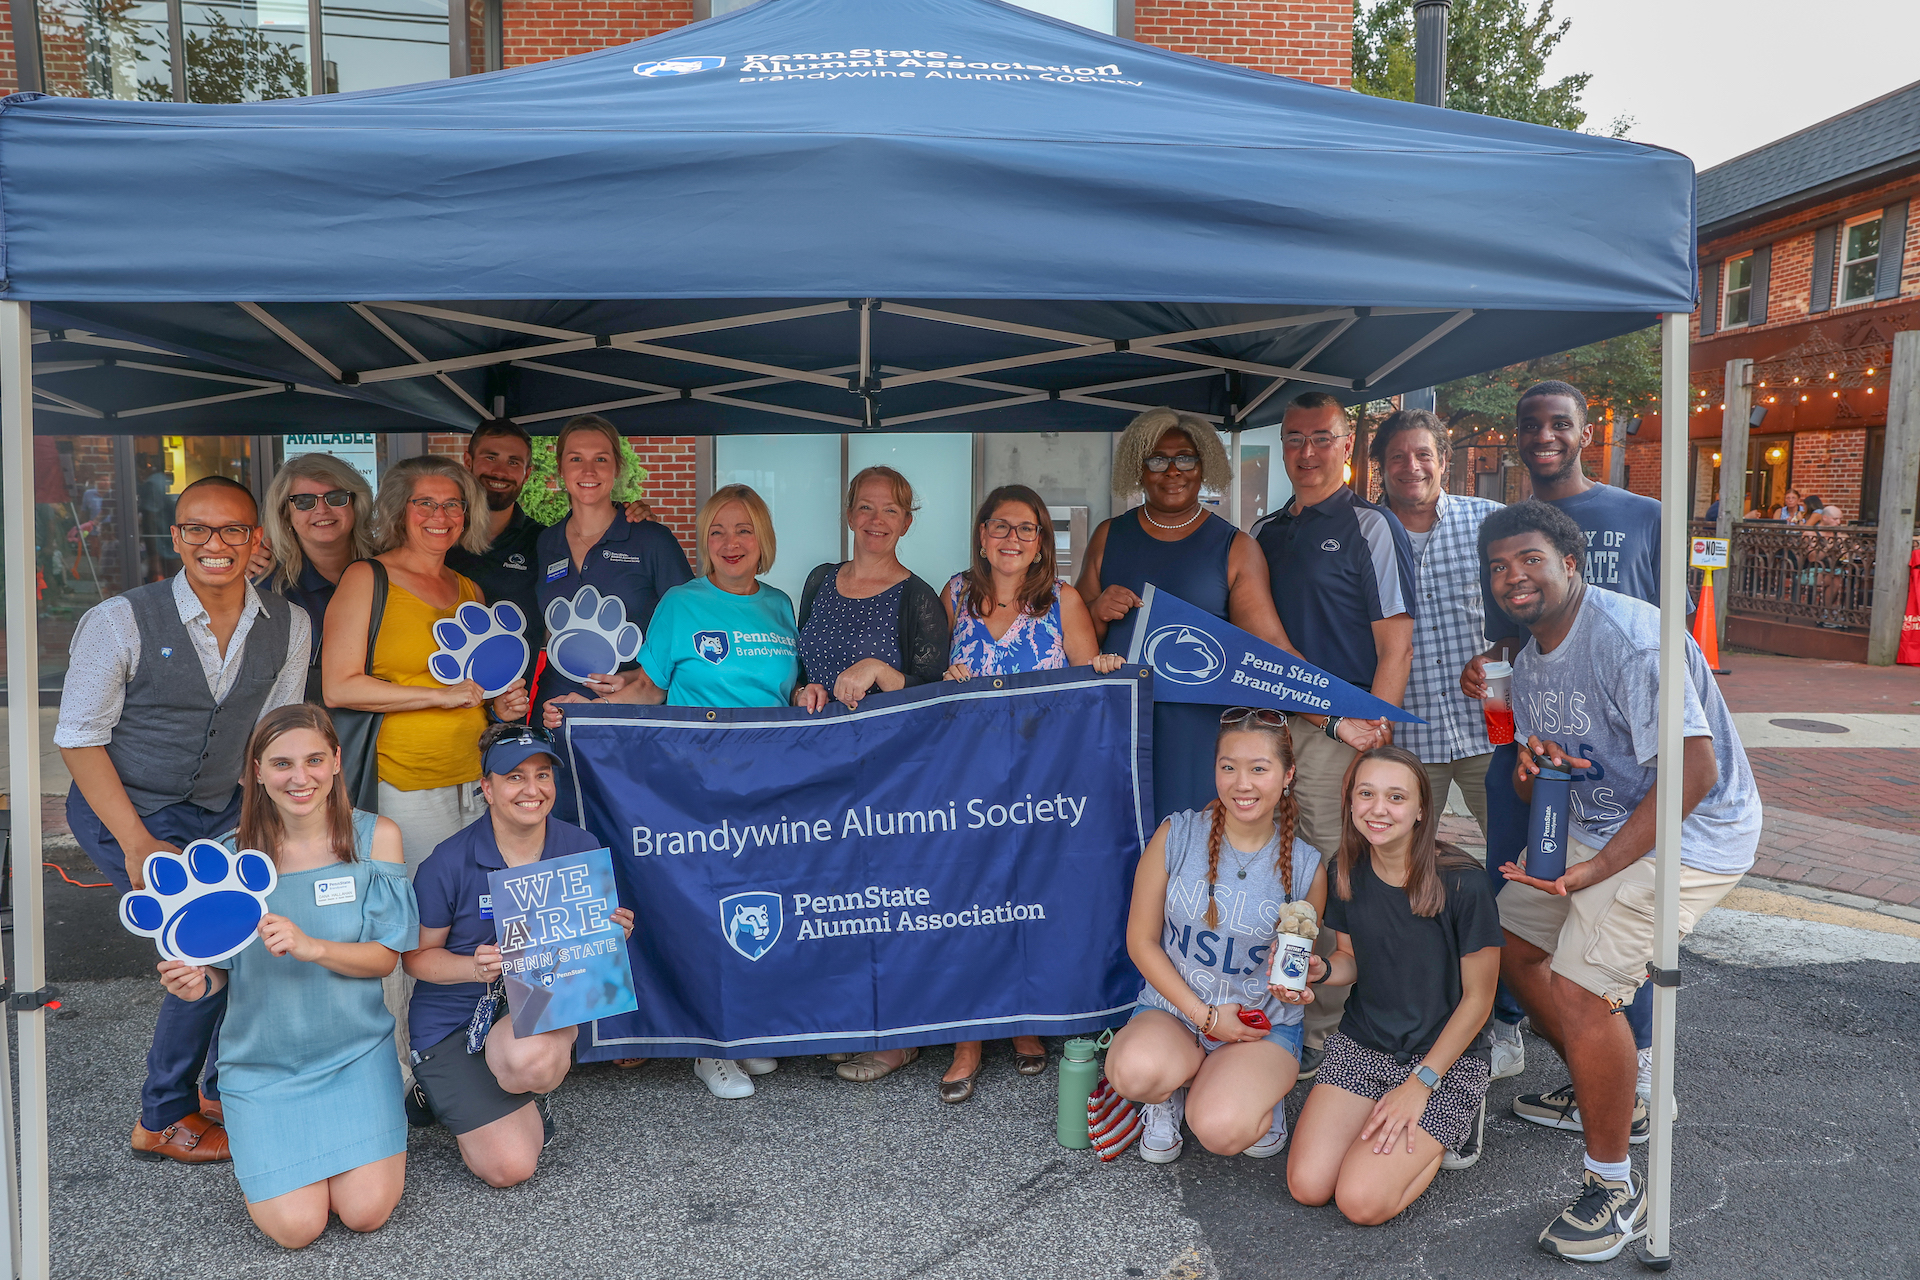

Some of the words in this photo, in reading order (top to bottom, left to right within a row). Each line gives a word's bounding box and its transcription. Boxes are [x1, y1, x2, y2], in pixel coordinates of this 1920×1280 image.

[739, 58, 888, 73] Alumni
[896, 58, 1123, 76] Association
[924, 70, 1031, 81] Alumni
[286, 432, 374, 445] AVAILABLE
[1603, 530, 1626, 547] OF
[1705, 541, 1715, 555] NO
[732, 630, 797, 647] PennState
[1240, 651, 1284, 675] Penn
[1286, 664, 1330, 688] State
[1230, 669, 1332, 710] Brandywine
[1527, 691, 1591, 737] NSLS
[631, 814, 832, 858] Brandywine
[841, 800, 957, 839] Alumni
[966, 792, 1087, 829] Society
[503, 863, 592, 912] WE
[792, 884, 931, 916] PennState
[500, 897, 611, 954] ARE
[796, 910, 891, 941] Alumni
[896, 899, 1046, 933] Association
[1167, 875, 1282, 941] NSLS
[500, 951, 554, 976] PENN
[558, 938, 618, 962] STATE
[1168, 915, 1270, 976] NSLS
[556, 967, 587, 979] PennState
